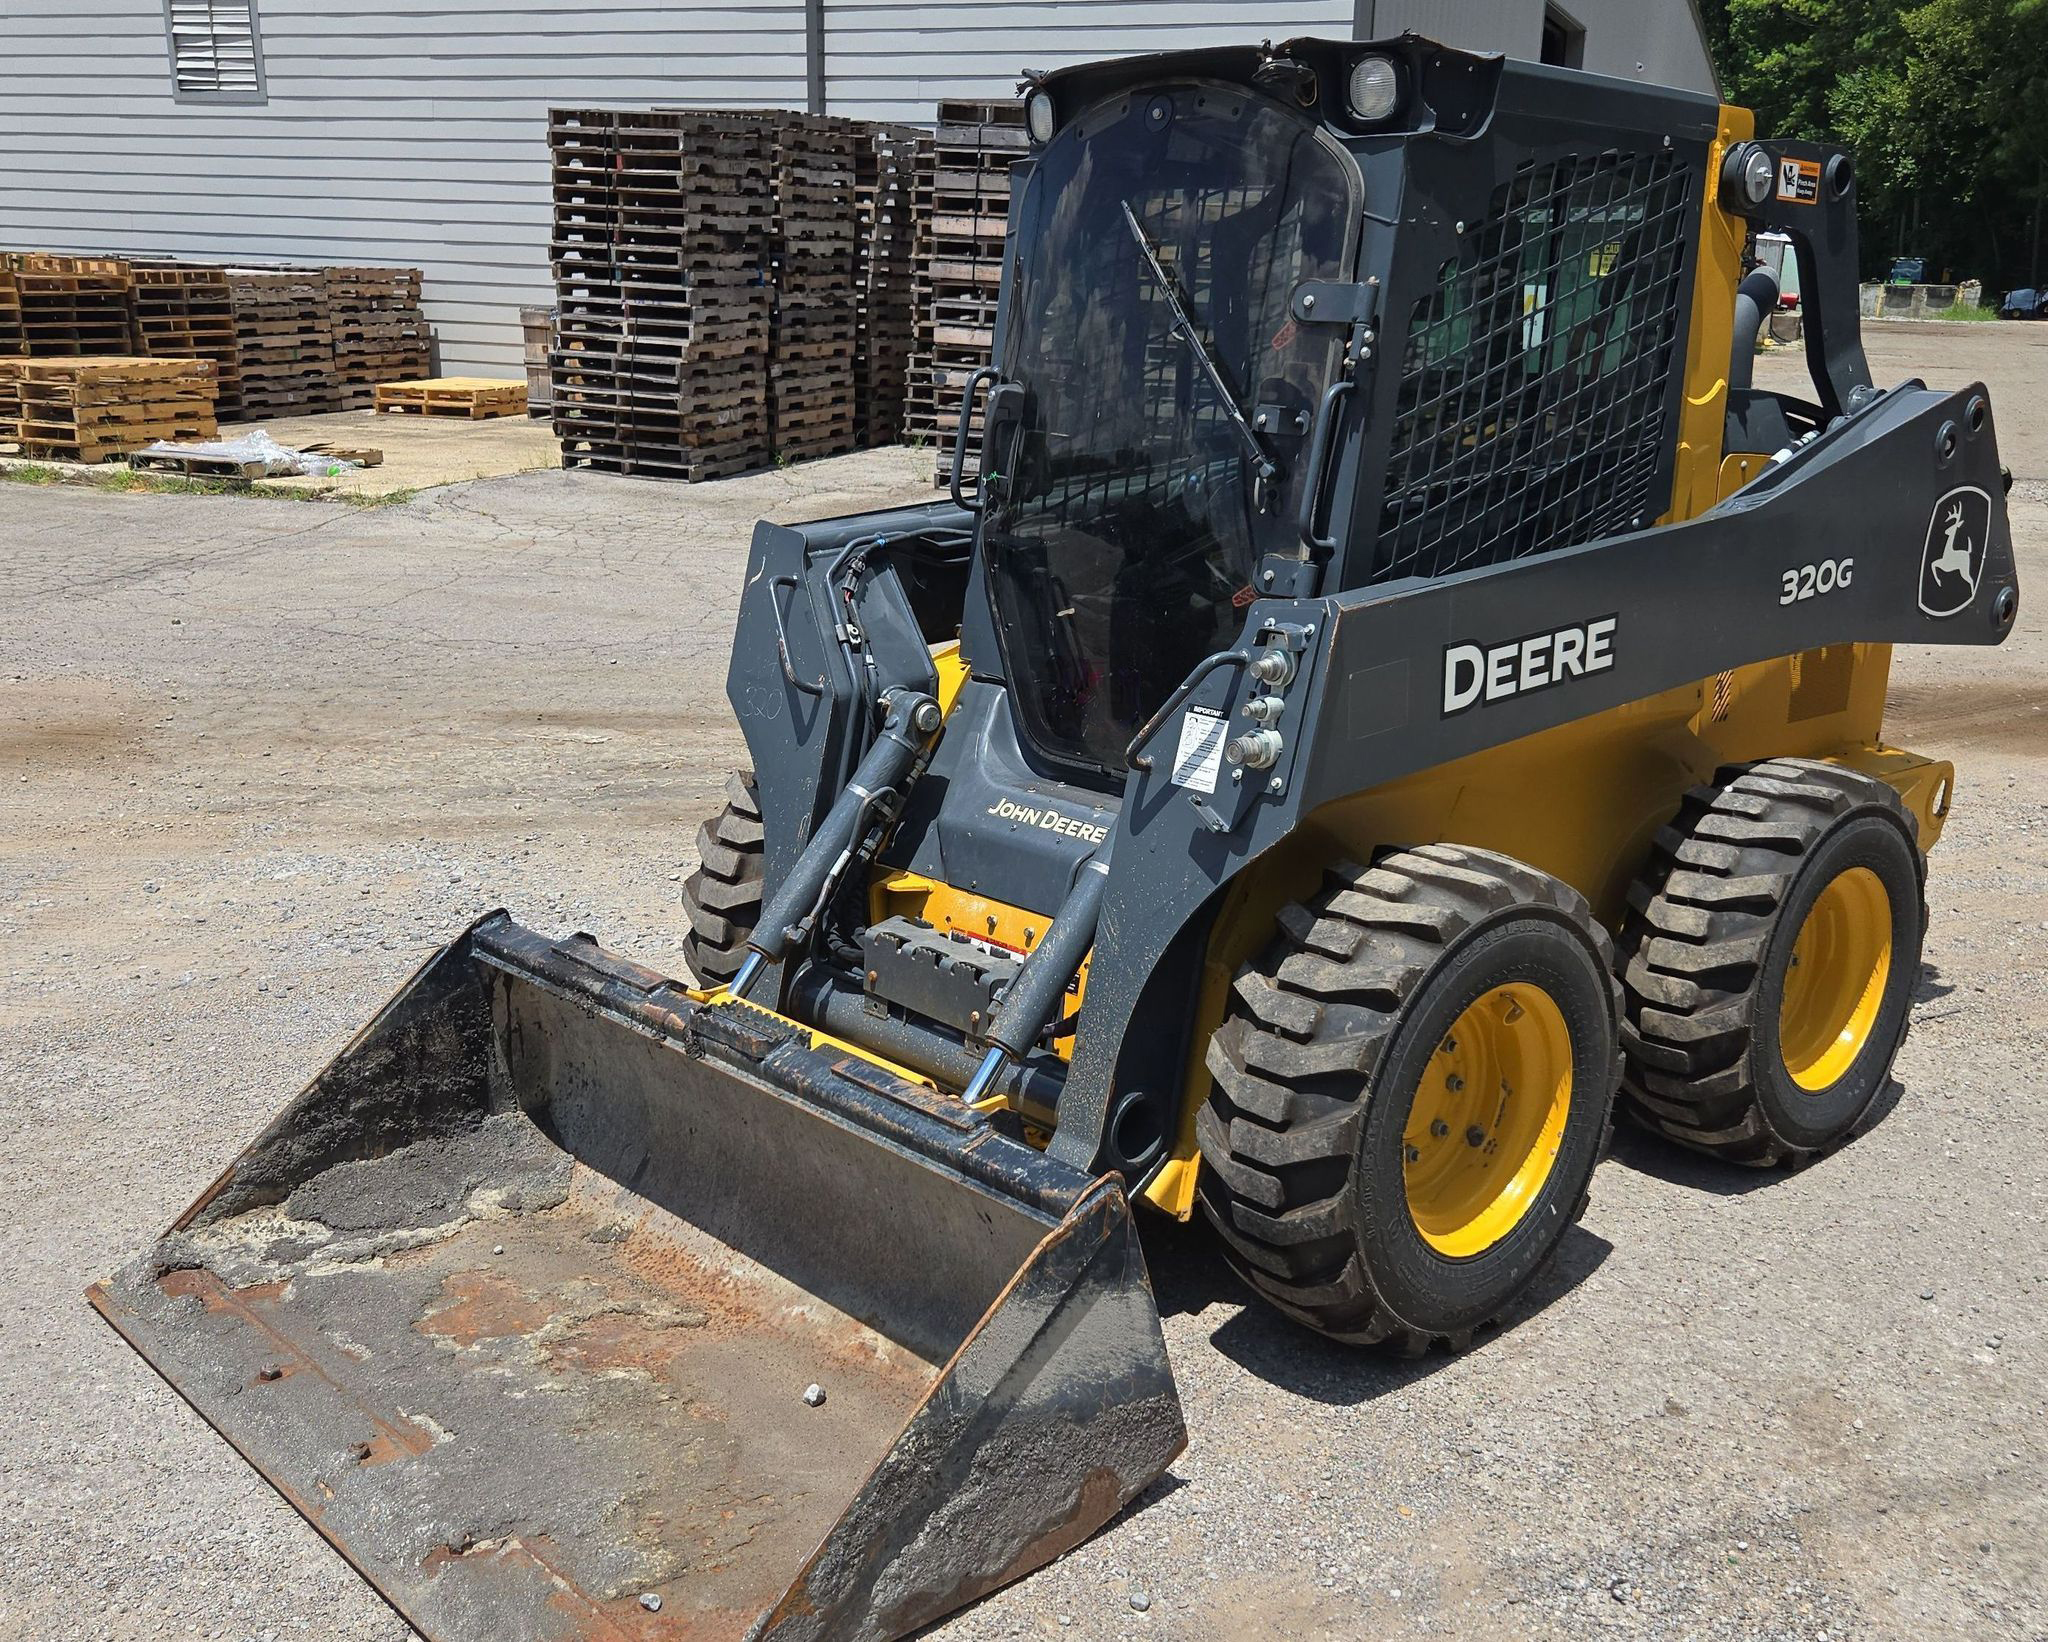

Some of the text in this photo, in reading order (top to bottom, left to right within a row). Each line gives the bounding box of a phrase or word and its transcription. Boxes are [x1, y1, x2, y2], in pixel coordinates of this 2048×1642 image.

[1780, 558, 1854, 605] 320G
[1443, 617, 1616, 713] DEERE
[1193, 705, 1224, 718] IMPORTANT
[987, 797, 1111, 844] JOHN DEERE
